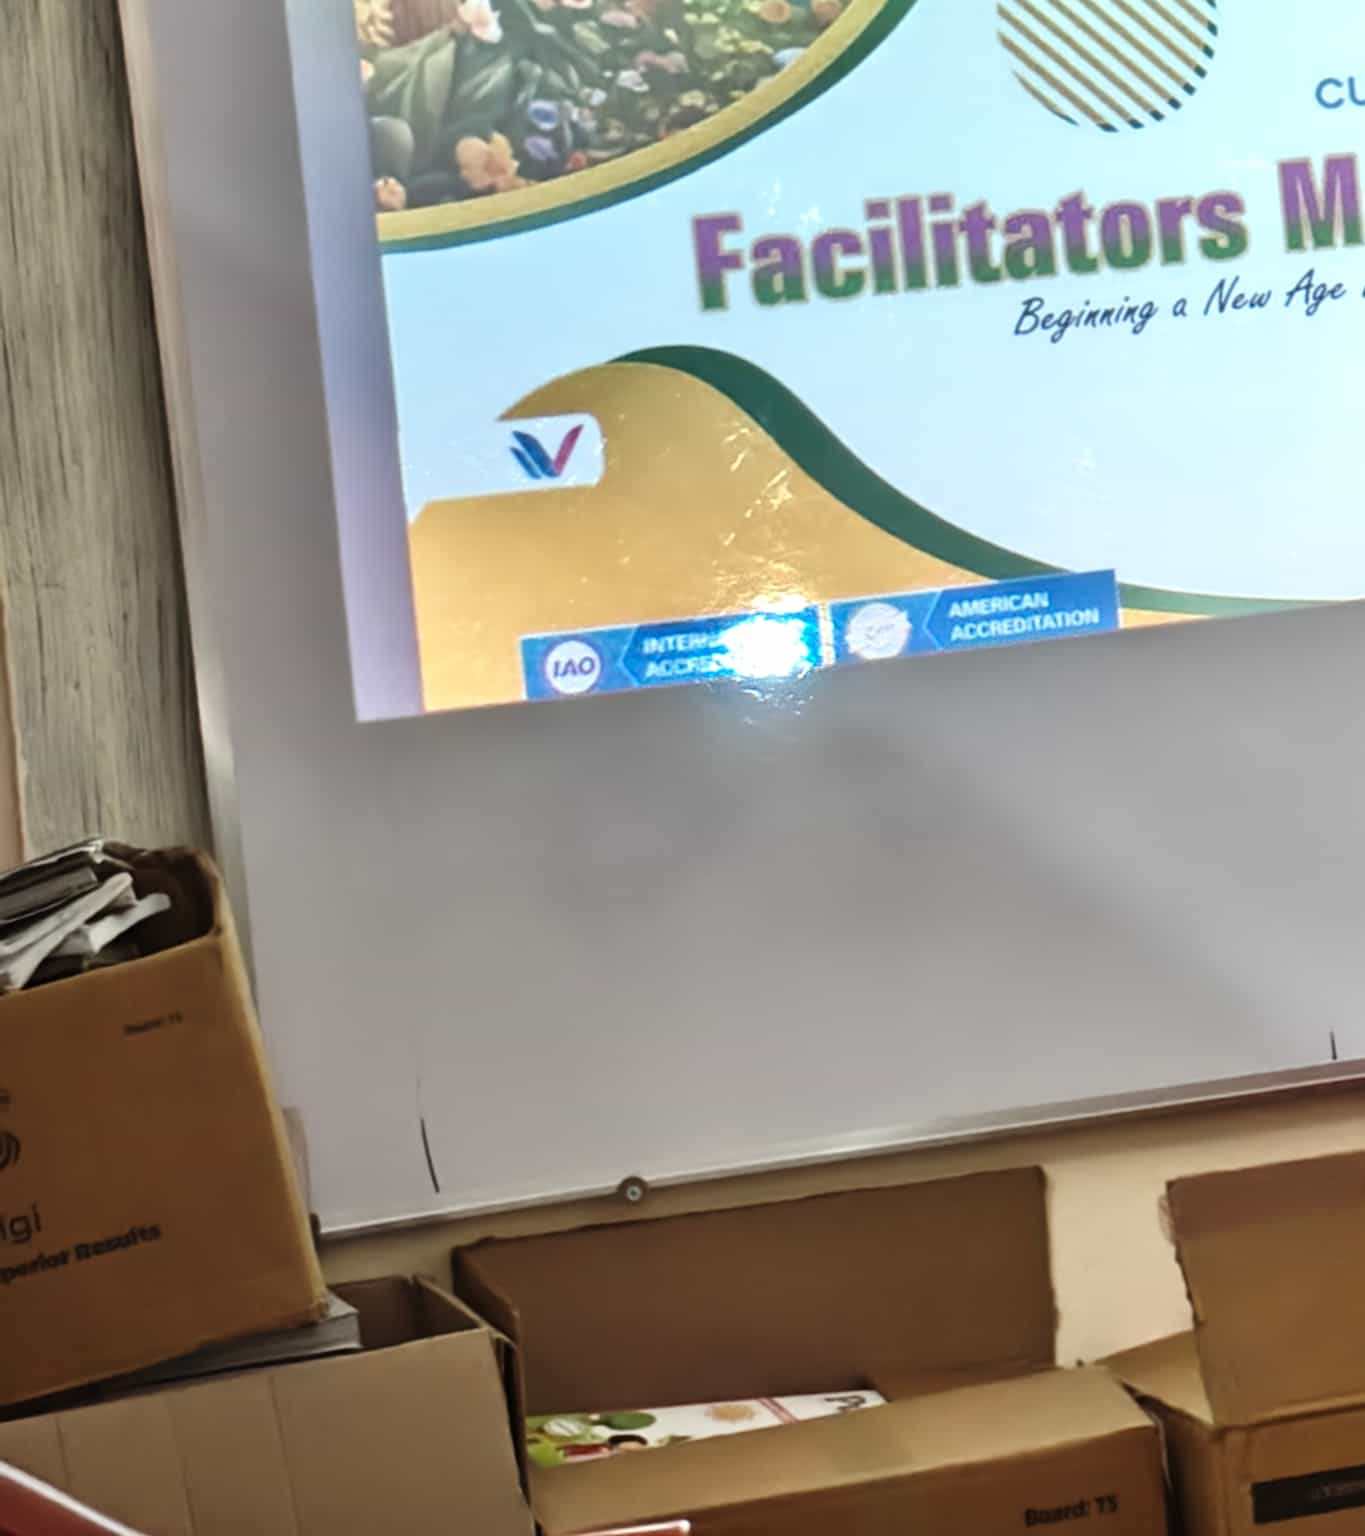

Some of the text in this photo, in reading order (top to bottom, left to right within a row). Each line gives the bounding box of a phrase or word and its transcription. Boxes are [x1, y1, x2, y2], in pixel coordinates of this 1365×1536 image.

[690, 187, 1251, 312] Facilitators
[1013, 295, 1159, 343] Beginning
[1172, 298, 1188, 317] a
[1203, 275, 1273, 316] New
[1284, 267, 1347, 316] Age
[949, 591, 1049, 618] AMERICAN
[951, 608, 1100, 642] ACCREDITATION
[553, 655, 596, 678] IAO
